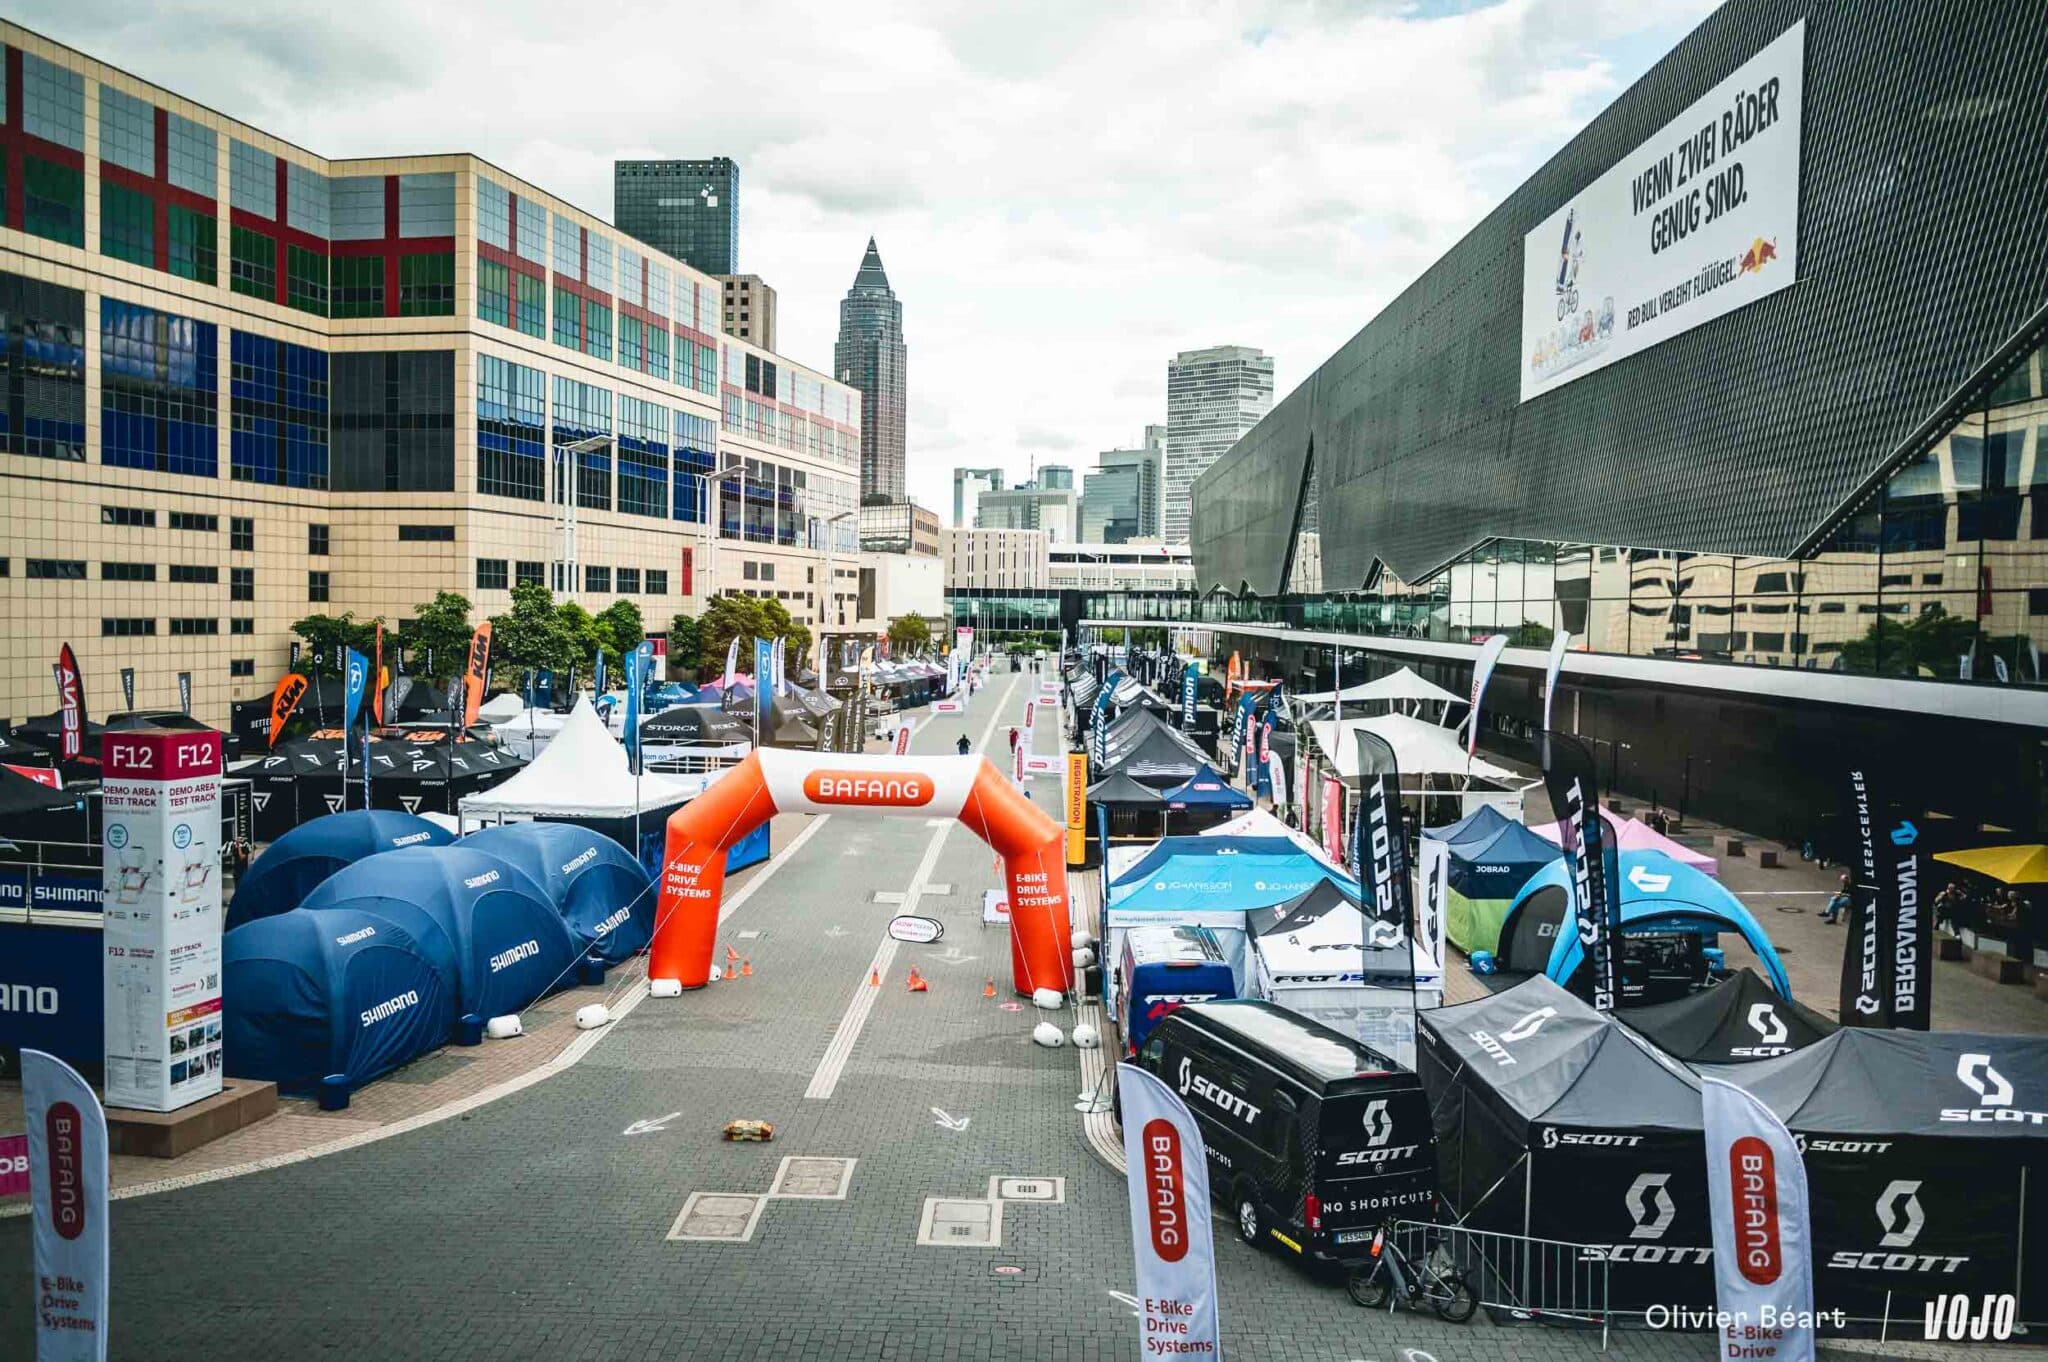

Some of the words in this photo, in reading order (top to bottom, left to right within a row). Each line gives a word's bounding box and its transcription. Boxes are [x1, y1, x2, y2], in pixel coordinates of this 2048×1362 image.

[1632, 152, 1673, 217] WENN
[1677, 120, 1716, 187] ZWEI
[1722, 76, 1780, 159] RÄDER
[1651, 187, 1700, 256] GENUG
[1705, 162, 1748, 226] SIND.
[1627, 308, 1641, 331] RED
[1642, 298, 1658, 325] BULL
[1659, 280, 1691, 315] VERLEIHT
[473, 634, 488, 681] KTM
[276, 679, 305, 720] KTM
[1185, 677, 1195, 723] pinion
[1096, 708, 1105, 767] pinion
[1231, 706, 1245, 766] pinion
[112, 745, 153, 769] F12
[178, 743, 213, 768] F12
[103, 785, 130, 795] DEMO
[132, 788, 156, 796] AREA
[169, 786, 193, 797] DEMO
[195, 783, 215, 793] AREA
[819, 777, 920, 799] BAFANG
[1073, 759, 1081, 824] REGISTRATION
[104, 798, 124, 806] TEST
[127, 799, 157, 807] TRACK
[169, 797, 189, 807] TEST
[191, 793, 216, 803] TRACK
[392, 831, 431, 848] SHIMANO
[562, 847, 598, 875] SHIMANO
[669, 861, 701, 874] E-BIKE
[463, 869, 500, 889] SHIMANO
[668, 874, 698, 886] DRIVE
[1016, 873, 1048, 883] E-BIKE
[666, 886, 711, 900] SYSTEMS
[1017, 885, 1048, 895] DRIVE
[1017, 895, 1062, 906] SYSTEMS
[593, 906, 631, 938] SHIMANO
[336, 926, 376, 946] SHIMANO
[108, 947, 125, 956] F12
[490, 939, 540, 973] SHIMANO
[1273, 975, 1337, 983] FELT
[360, 990, 420, 1027] SHIMANO
[1470, 1030, 1517, 1067] SCOTT
[1191, 1074, 1261, 1126] SCOTT
[1560, 1133, 1644, 1147] SCOTT
[1809, 1140, 1892, 1153] SCOTT
[1336, 1145, 1419, 1165] SCOTT
[56, 1118, 76, 1224] BAFANG
[1152, 1136, 1179, 1246] BAFANG
[1323, 1201, 1344, 1214] NO
[1350, 1190, 1433, 1211] SHORTCUTS
[1741, 1154, 1770, 1268] BAFANG
[1577, 1244, 1714, 1264] SCOTT
[1827, 1252, 1970, 1273] SCOTT
[41, 1277, 85, 1293] E-Bike
[43, 1295, 79, 1311] Drive
[1146, 1299, 1193, 1316] E-Bike
[42, 1312, 95, 1332] Systems
[1146, 1318, 1188, 1334] Drive
[1727, 1325, 1783, 1341] E-Bike
[1147, 1337, 1213, 1354] Systems
[1728, 1343, 1777, 1359] Drive
